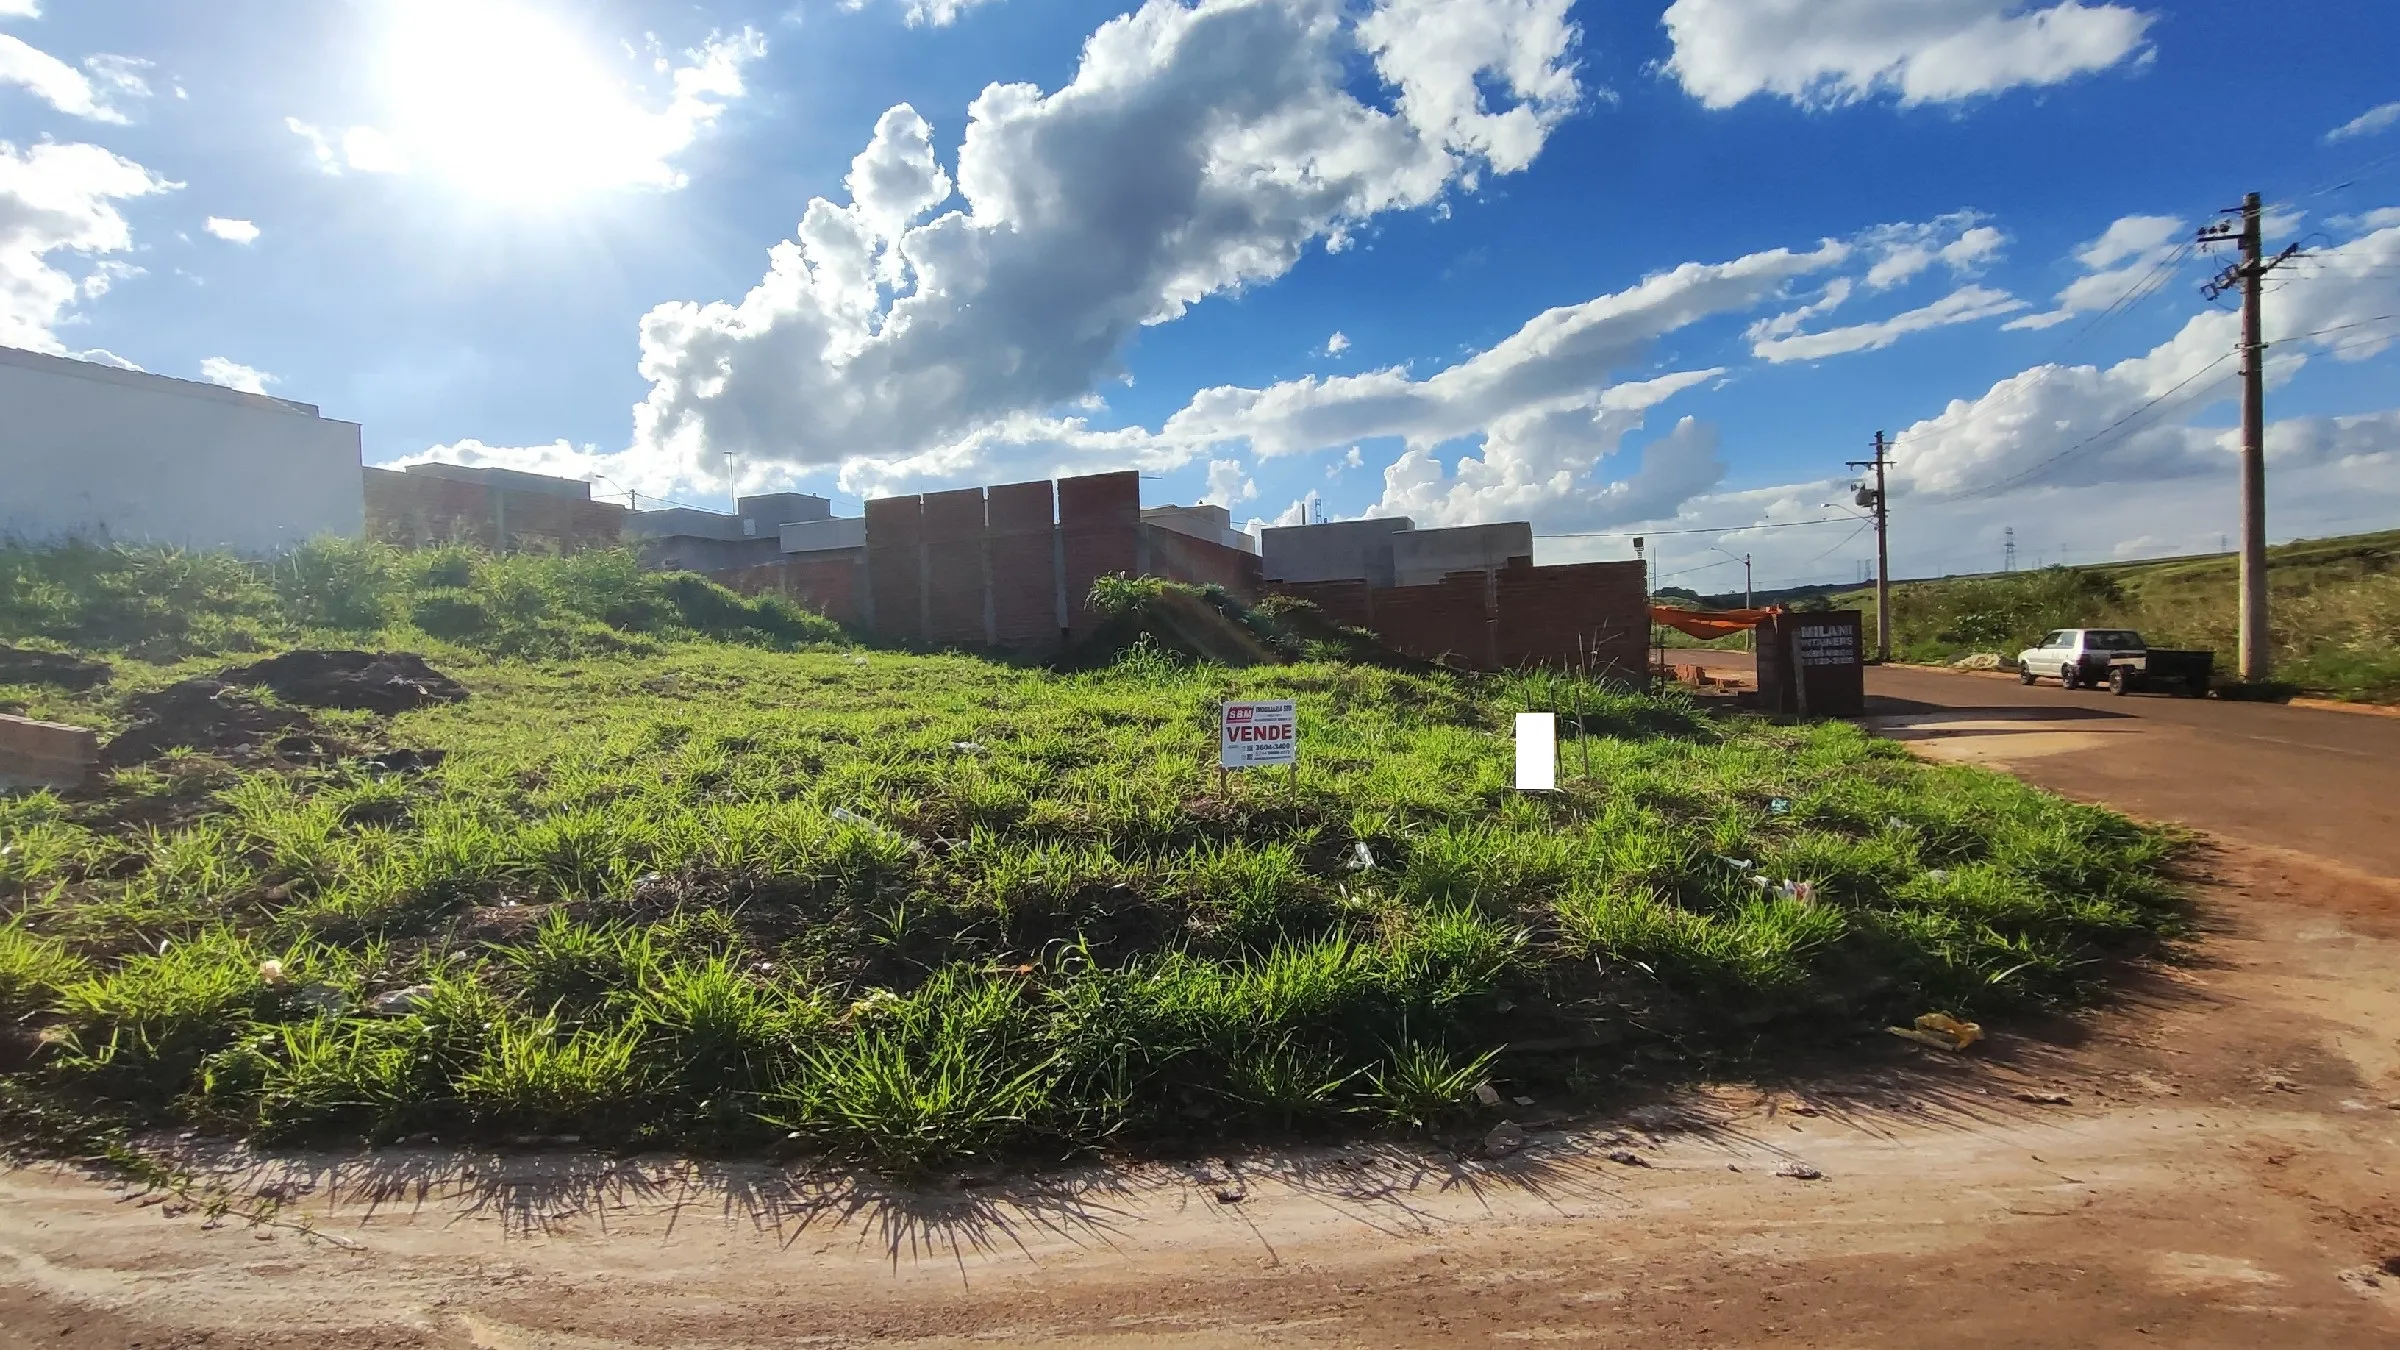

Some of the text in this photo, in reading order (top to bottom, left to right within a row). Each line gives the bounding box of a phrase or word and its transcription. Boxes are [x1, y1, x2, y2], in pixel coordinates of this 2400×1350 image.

[1801, 625, 1852, 637] MILANI
[1229, 709, 1252, 719] SBM
[1226, 724, 1292, 742] VENDE
